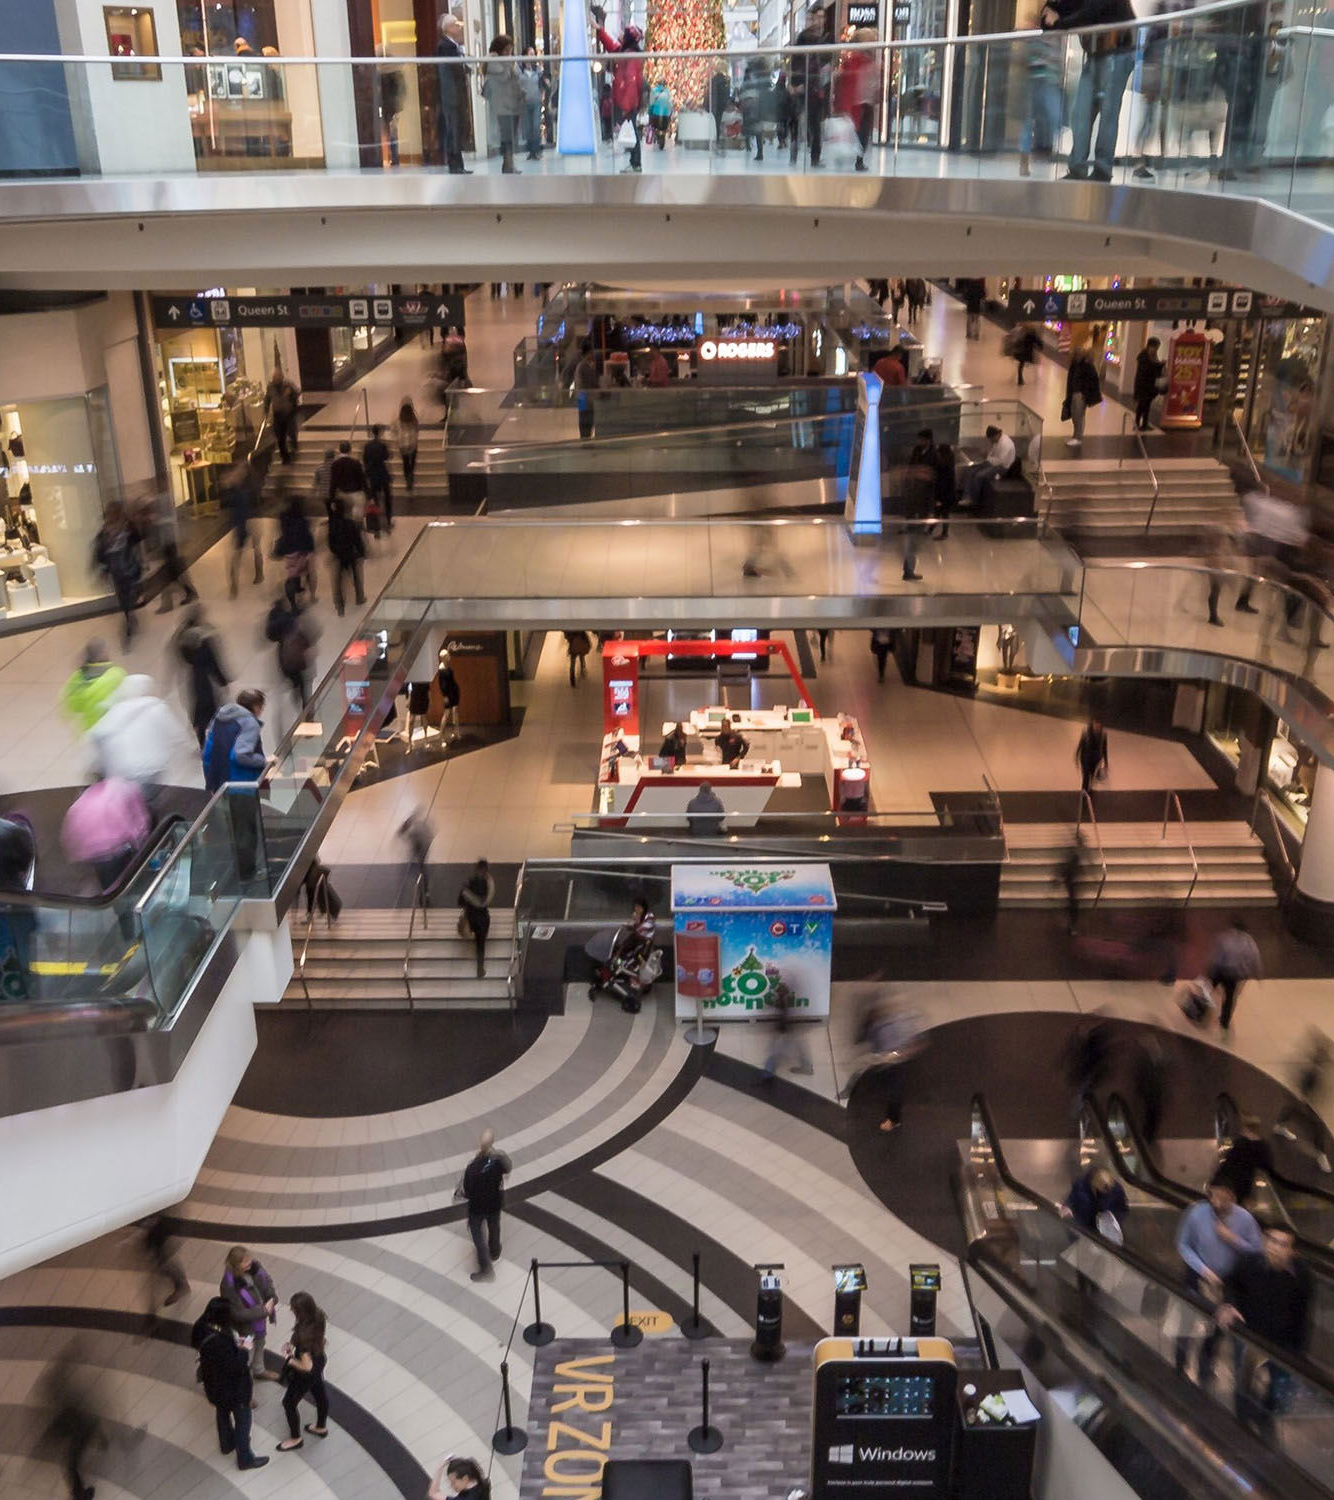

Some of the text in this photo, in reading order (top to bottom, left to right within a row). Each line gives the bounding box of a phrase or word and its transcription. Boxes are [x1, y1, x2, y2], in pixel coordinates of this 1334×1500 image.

[238, 305, 275, 317] Queen
[277, 305, 289, 316] St
[1094, 299, 1132, 310] Queen
[1134, 299, 1146, 309] St
[718, 342, 774, 358] ROGERS
[771, 921, 819, 937] CTV
[630, 1315, 659, 1327] EXIT
[551, 1355, 616, 1414] VR
[859, 1447, 936, 1461] Windows
